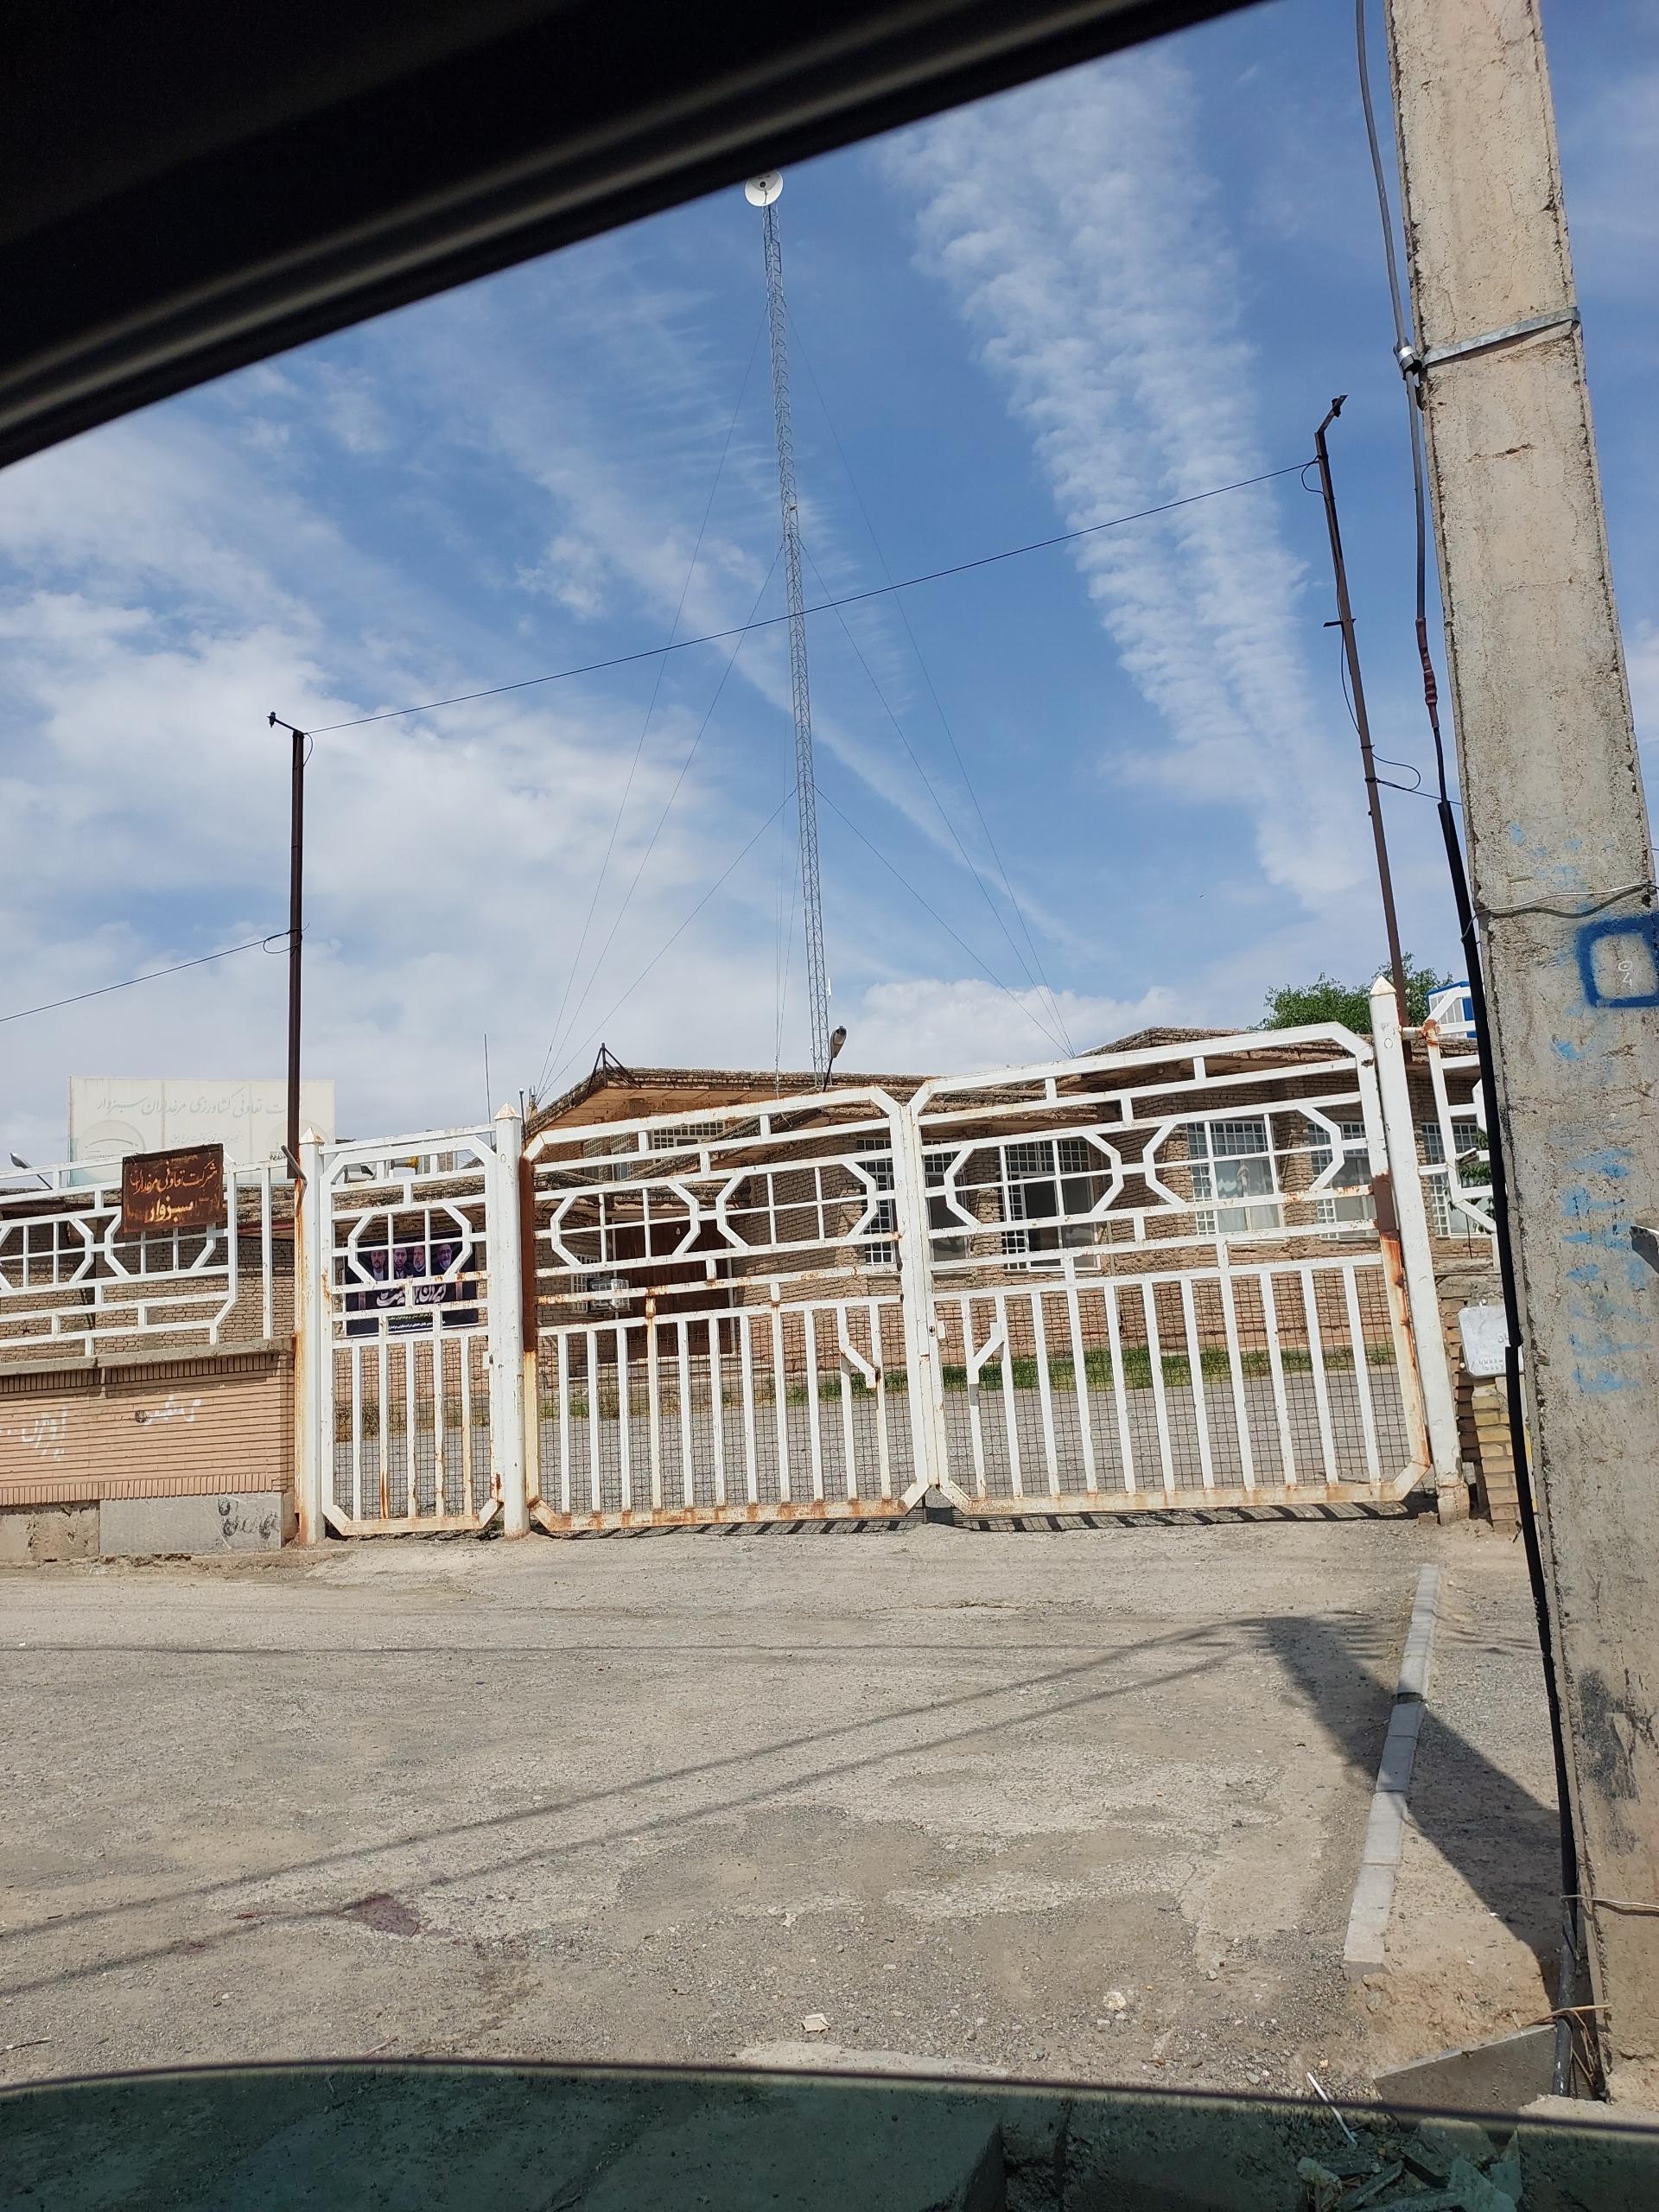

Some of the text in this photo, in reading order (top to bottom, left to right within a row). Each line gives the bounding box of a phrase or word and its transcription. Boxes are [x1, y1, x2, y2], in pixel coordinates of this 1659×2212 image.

[96, 1095, 149, 1118] سبزوار
[189, 1085, 246, 1115] کشاورزی
[232, 1092, 263, 1119] تعاونی
[156, 1160, 187, 1192] تعاونی
[182, 1158, 218, 1189] شرکت
[143, 1195, 194, 1224] سبزوار
